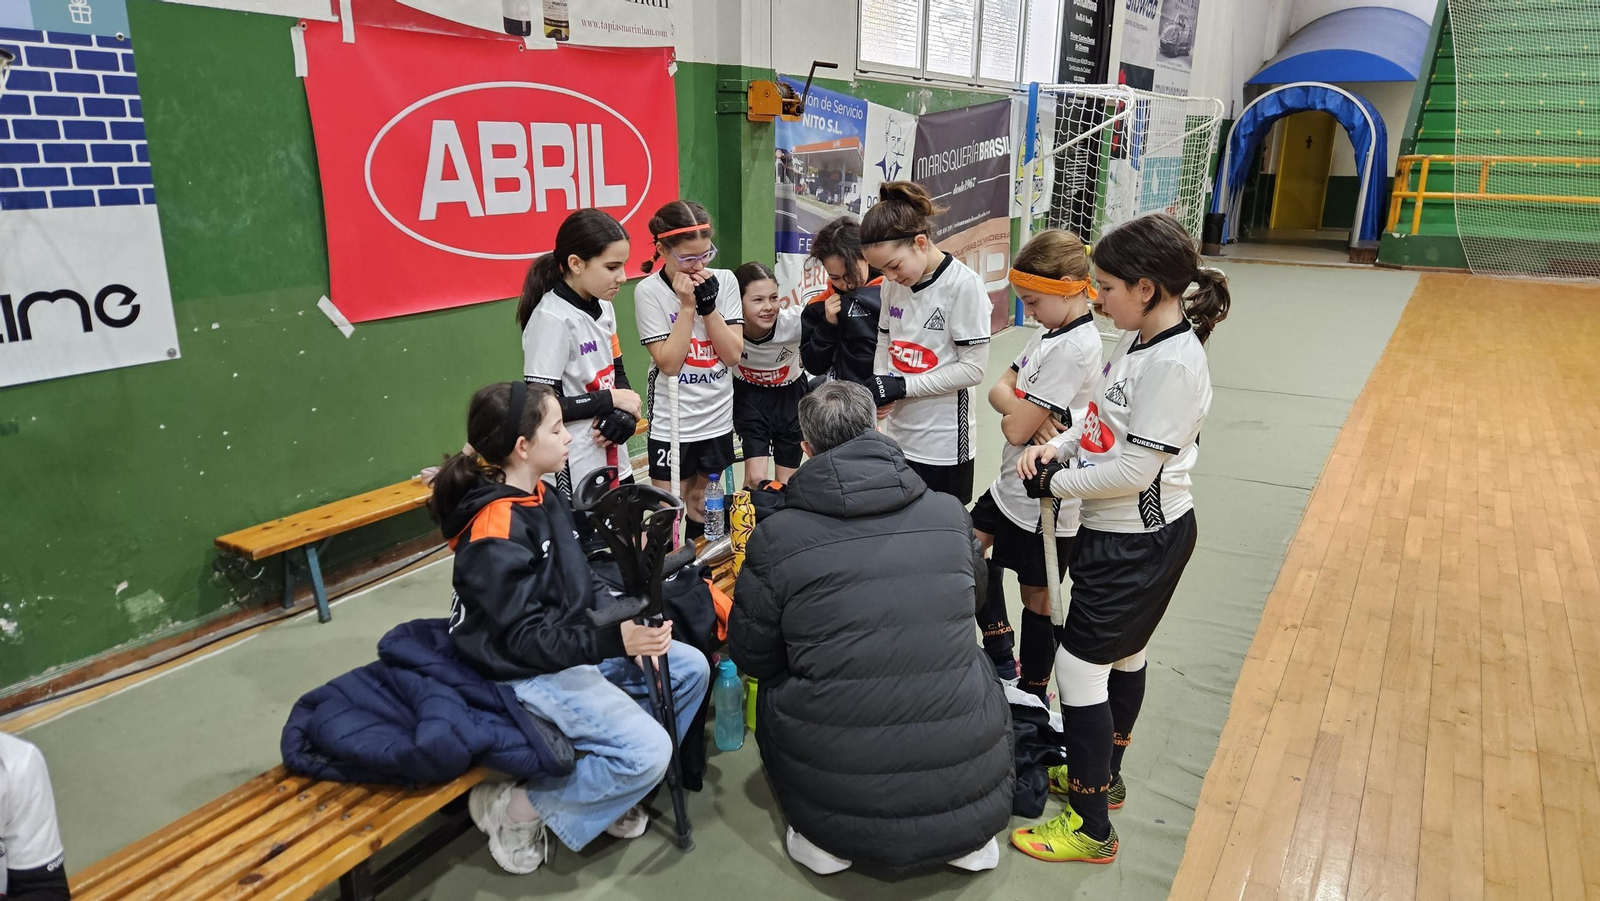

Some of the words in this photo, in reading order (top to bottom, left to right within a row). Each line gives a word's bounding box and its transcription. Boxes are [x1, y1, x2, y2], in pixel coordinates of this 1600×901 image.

[820, 95, 832, 112] de
[833, 99, 864, 120] Servicio
[827, 118, 843, 135] S.L.
[417, 119, 628, 221] ABRIL
[875, 376, 886, 398] KOROX
[1027, 395, 1052, 410] OURENSE
[1131, 437, 1166, 451] OURENSE
